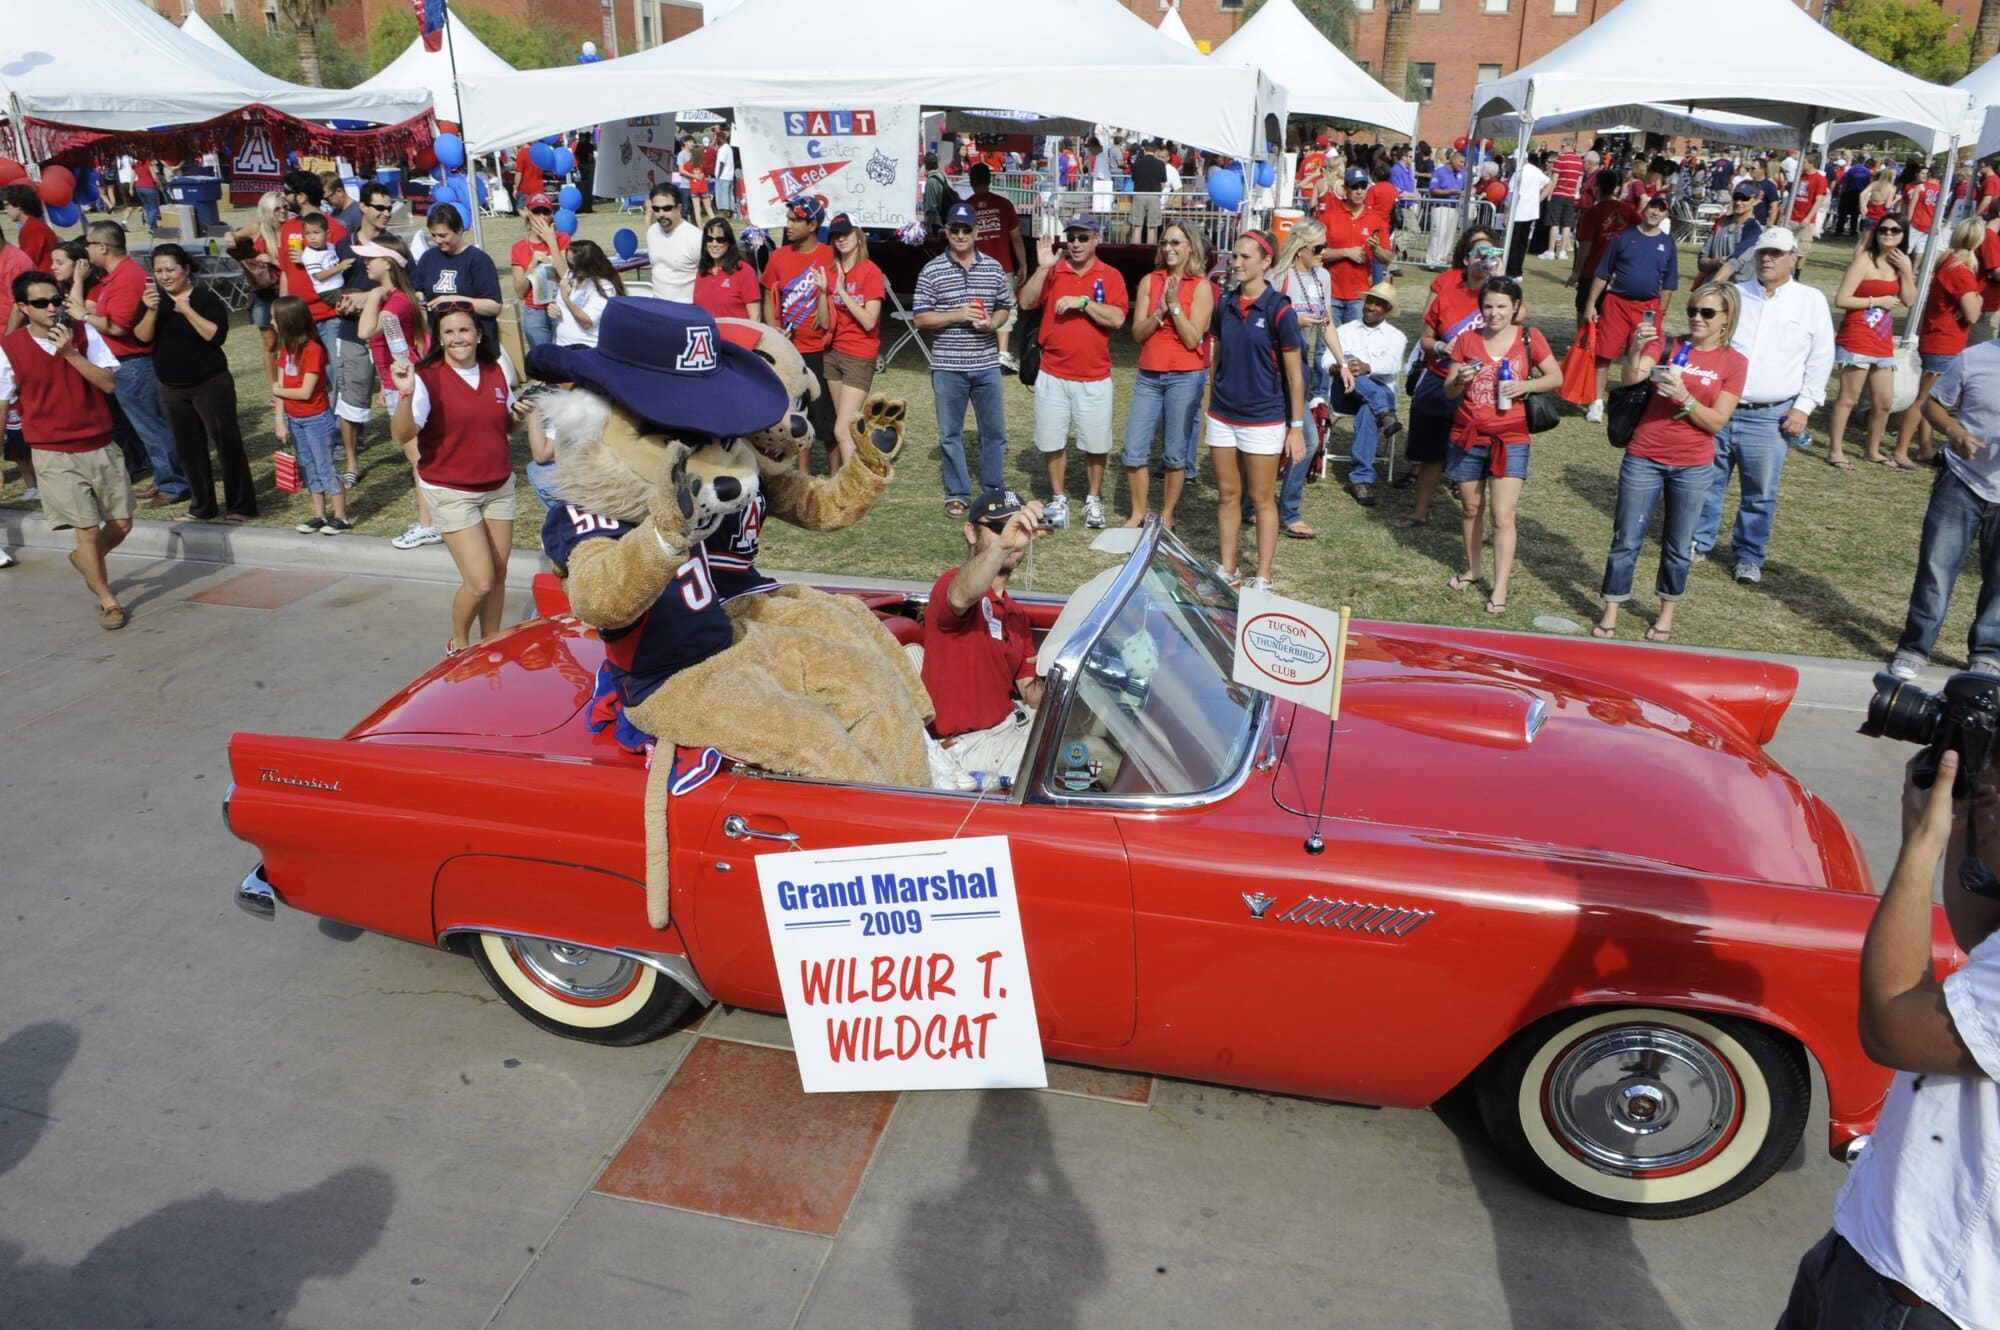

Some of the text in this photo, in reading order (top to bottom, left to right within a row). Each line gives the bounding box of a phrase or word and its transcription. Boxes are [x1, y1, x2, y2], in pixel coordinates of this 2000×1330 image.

[789, 113, 871, 135] SALT
[807, 140, 859, 159] Center
[780, 164, 828, 197] Aged
[846, 171, 865, 194] to
[433, 270, 457, 293] A
[676, 326, 716, 370] A
[729, 496, 765, 553] A
[1268, 620, 1307, 638] TUCSON
[1256, 636, 1315, 660] THUNDERBIRD
[1271, 663, 1297, 678] CLUB
[778, 866, 998, 911] Grand Marshal
[860, 909, 923, 936] 2009
[800, 950, 1007, 1006] WILBUR T.
[827, 1012, 998, 1063] WILDCAT
